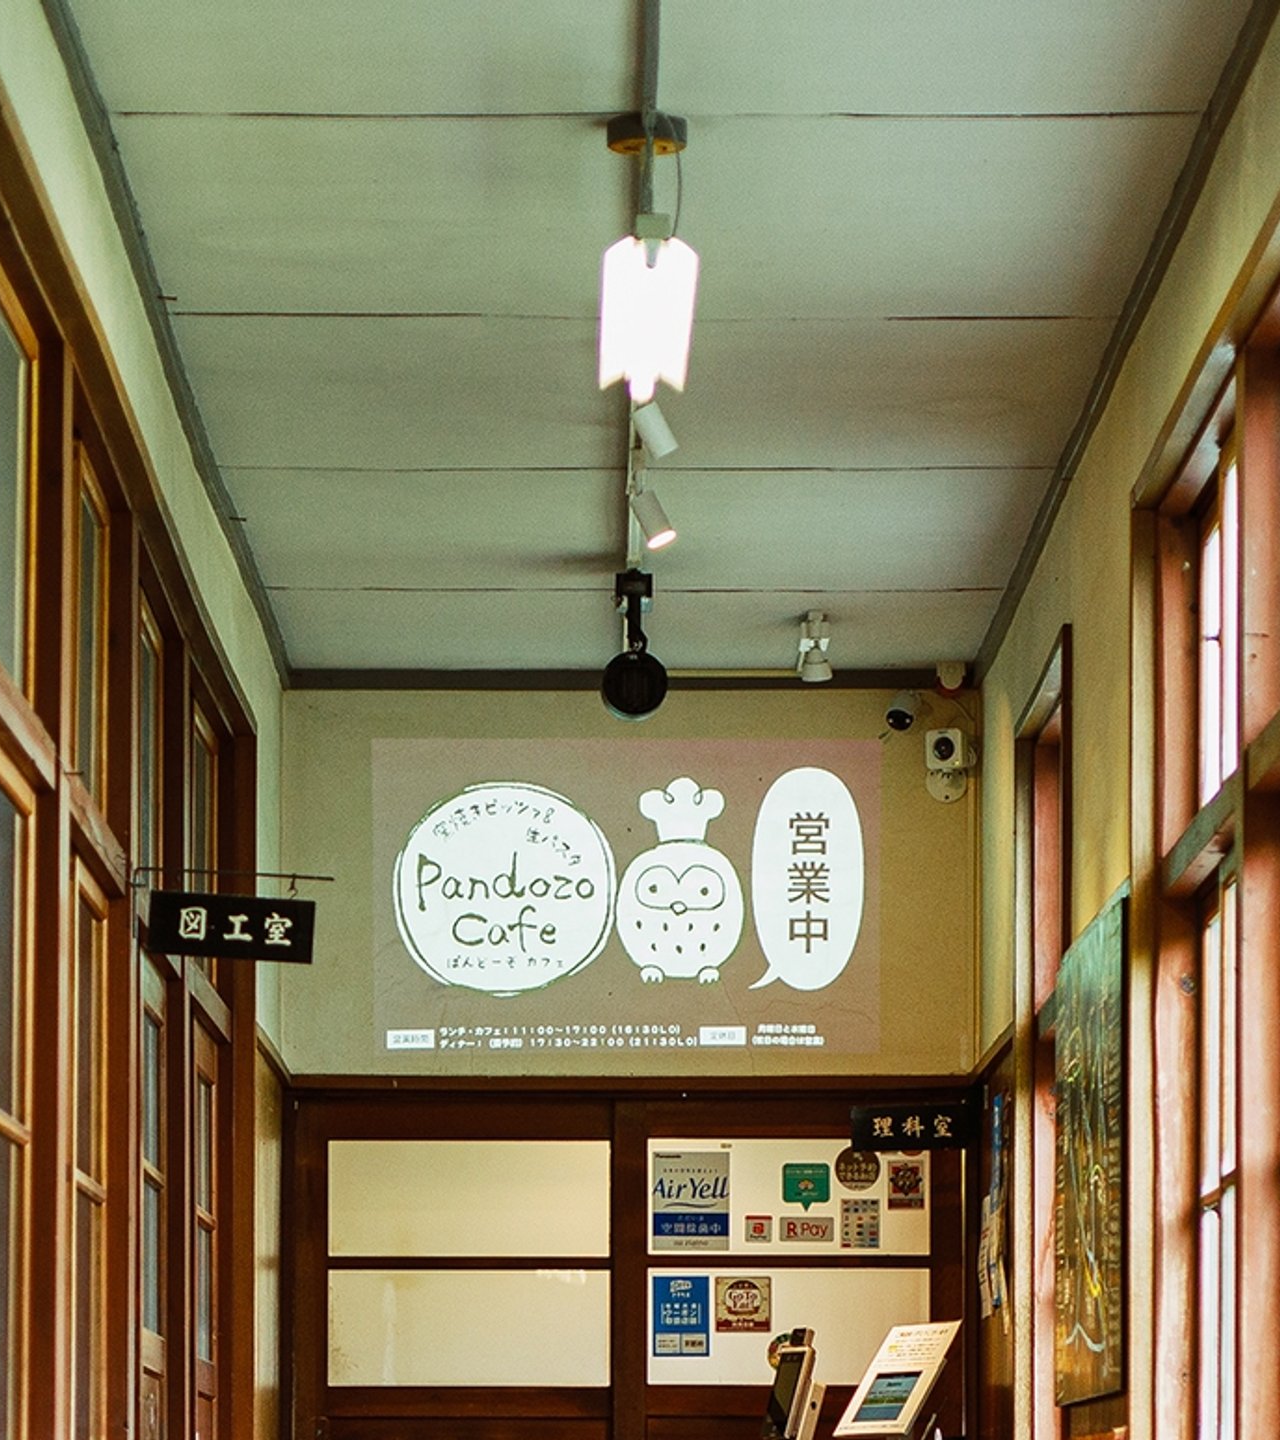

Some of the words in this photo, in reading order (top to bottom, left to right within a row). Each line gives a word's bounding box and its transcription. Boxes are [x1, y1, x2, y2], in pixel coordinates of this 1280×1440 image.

[416, 851, 596, 912] Pandozo
[787, 811, 831, 954] 営業中
[178, 906, 293, 947] 図工室
[452, 904, 557, 953] Cafe
[872, 1114, 953, 1139] 理科室
[801, 1222, 829, 1238] Pay
